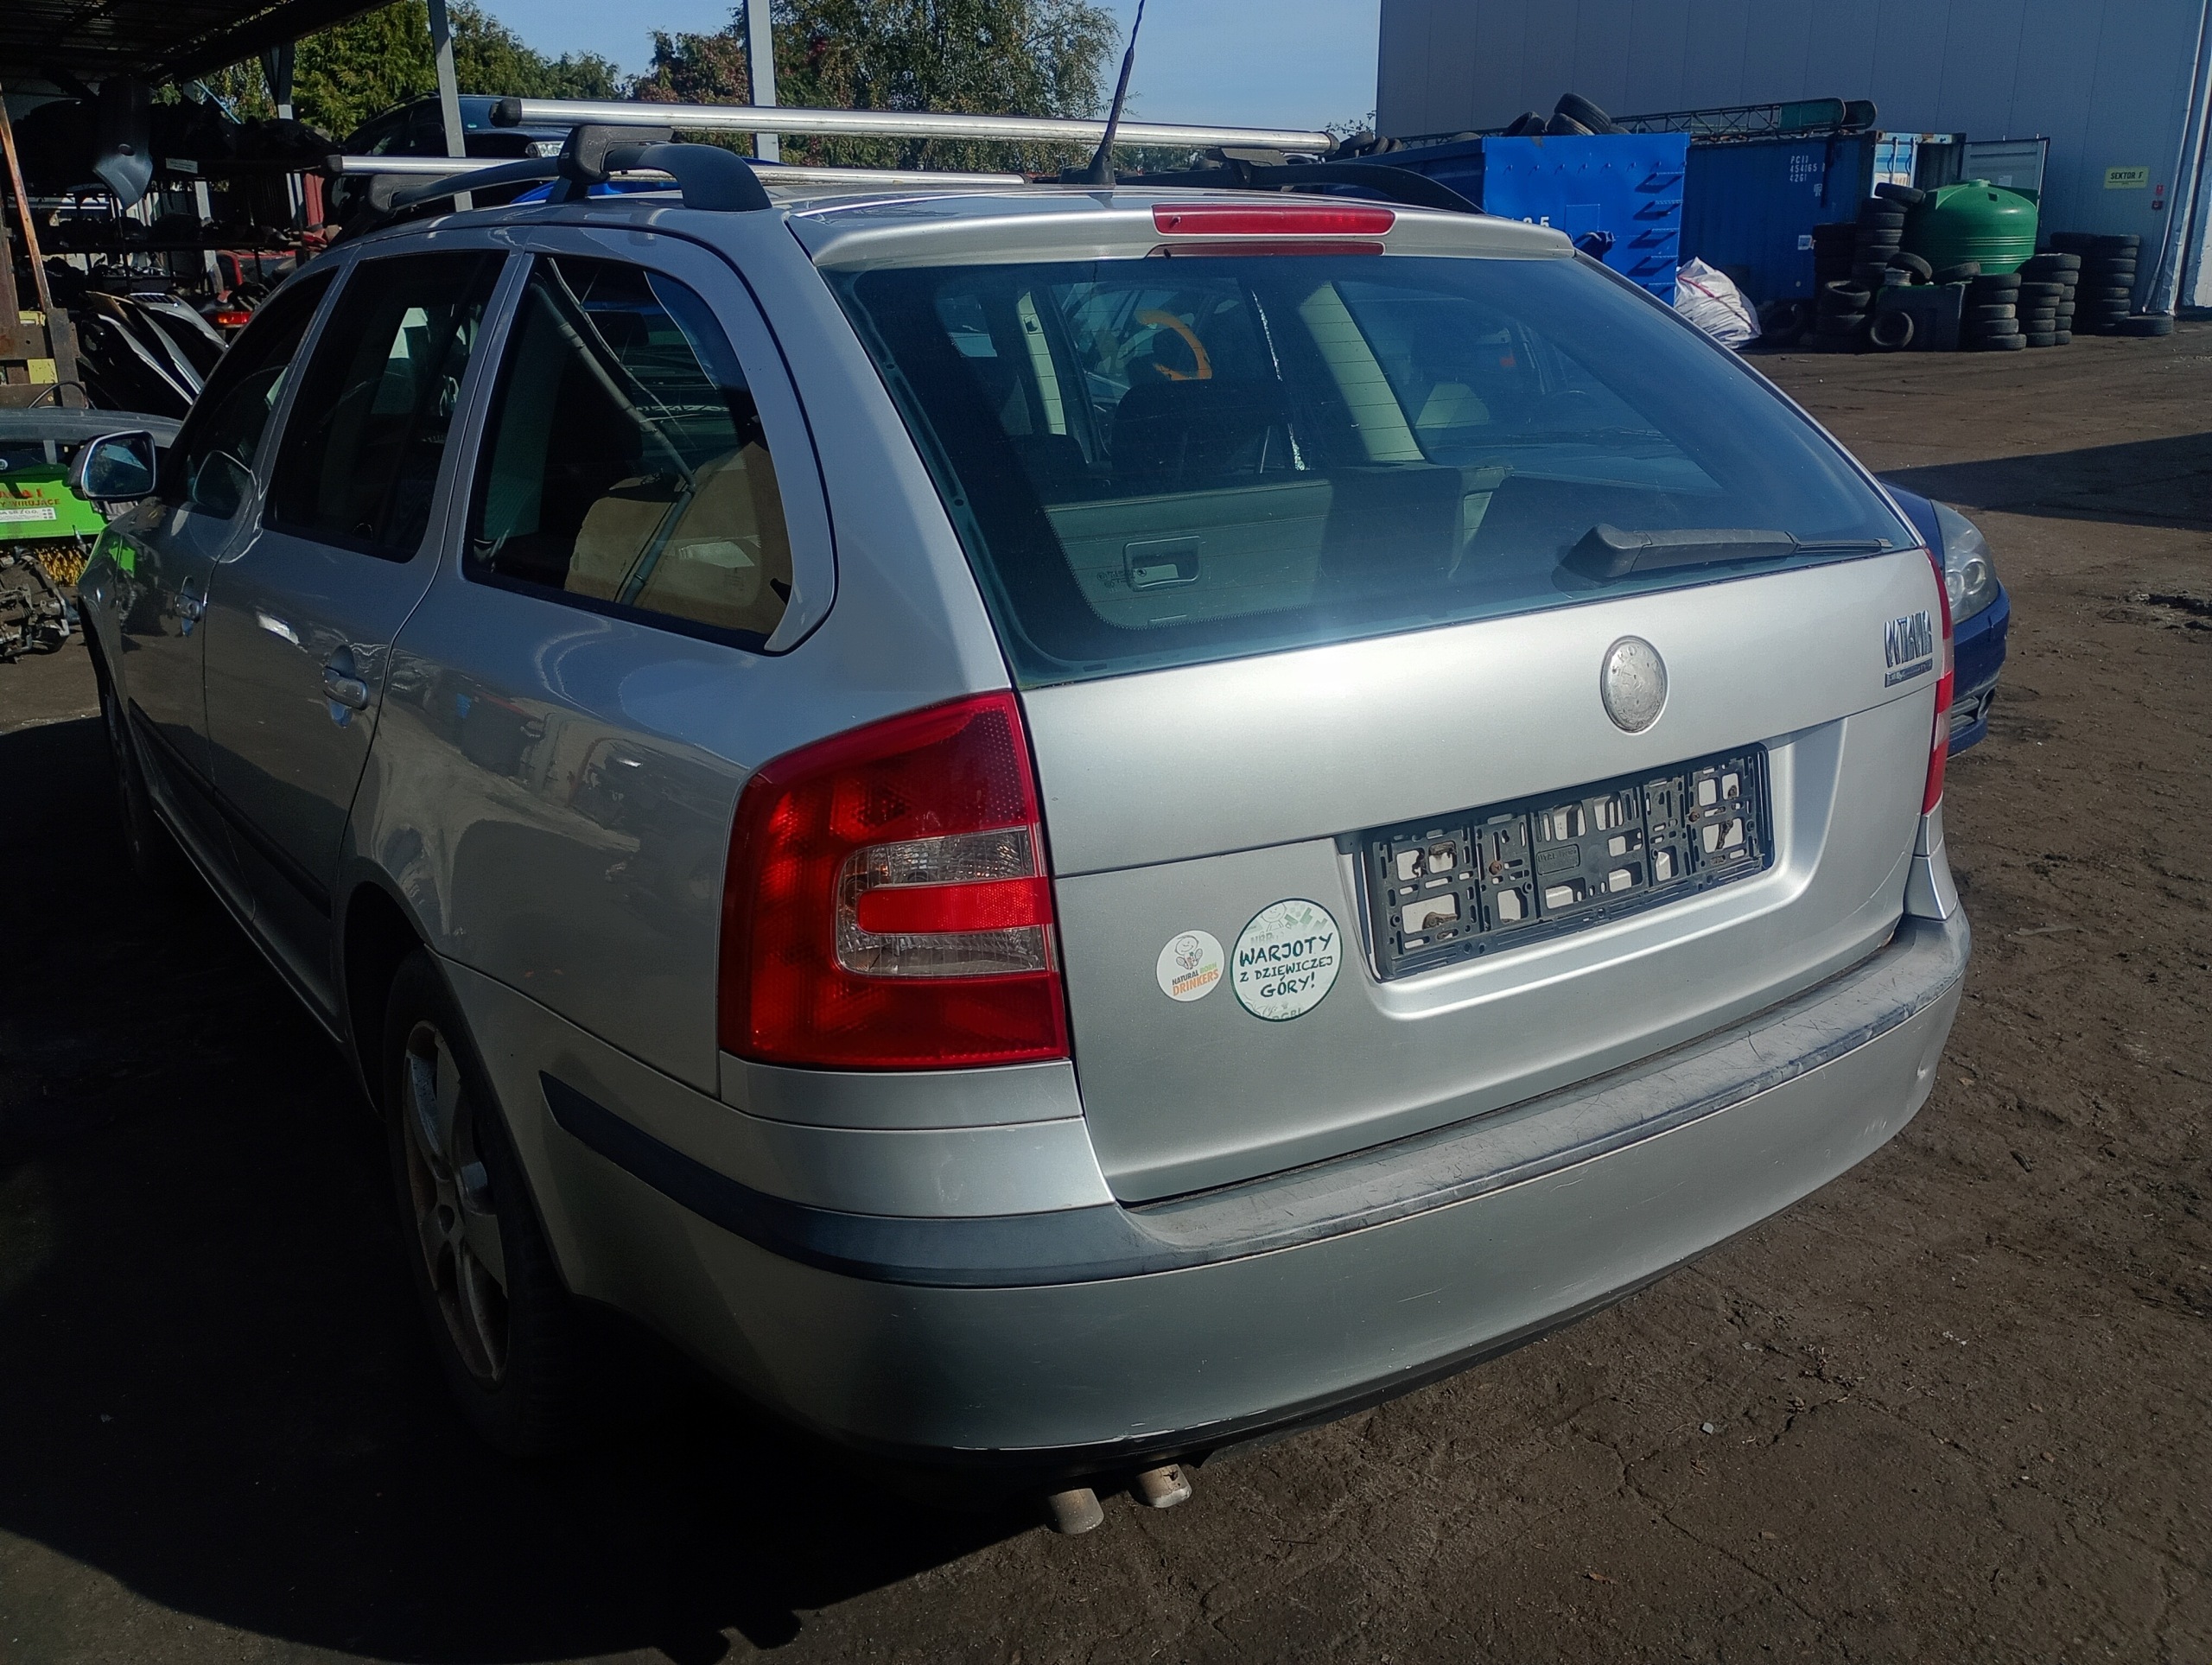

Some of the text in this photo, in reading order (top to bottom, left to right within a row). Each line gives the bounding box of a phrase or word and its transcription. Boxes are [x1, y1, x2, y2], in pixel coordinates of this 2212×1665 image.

[2110, 171, 2136, 180] SEKTOR
[1239, 932, 1333, 967] WARJOTY
[1172, 962, 1217, 986] NATURAL BORN
[1240, 955, 1333, 982] Z DZIEWICZEJ
[1173, 969, 1219, 996] DRINKERS
[1261, 971, 1315, 998] GÓRY!
